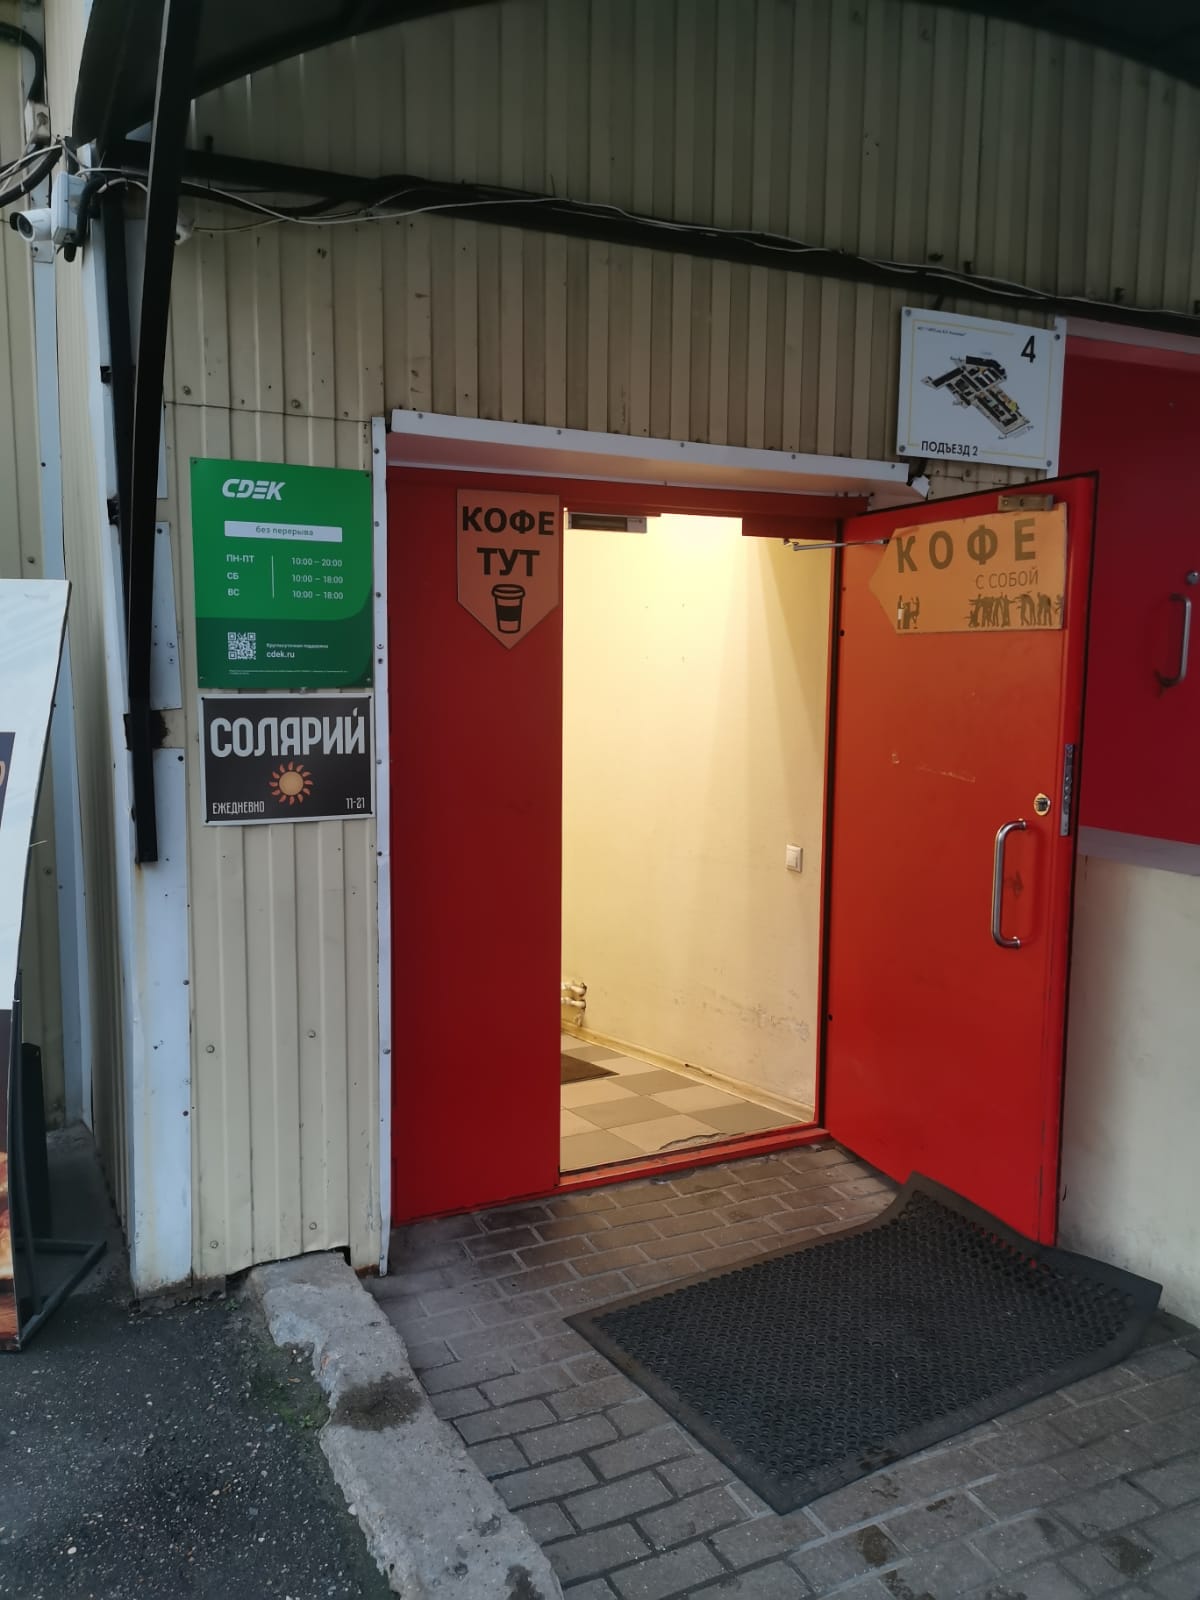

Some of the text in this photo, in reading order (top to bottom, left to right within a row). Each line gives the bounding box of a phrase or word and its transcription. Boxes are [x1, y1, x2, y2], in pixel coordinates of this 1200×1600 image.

[1020, 335, 1036, 364] 4
[921, 440, 978, 456] ПОДЪЕЗД 2
[222, 478, 286, 500] CDEK
[462, 506, 555, 536] КОФЕ
[255, 525, 314, 537] без перерыва
[896, 518, 1036, 574] КОФЕ
[226, 554, 255, 564] ПН-ПТ
[291, 557, 313, 566] 10:00
[321, 558, 343, 567] 20:00
[477, 547, 540, 577] ТУТ
[226, 572, 240, 580] СБ
[291, 574, 313, 583] 10:00
[322, 575, 344, 584] 18:00
[975, 567, 1039, 590] С СОБОЙ
[227, 588, 240, 597] ВС
[292, 590, 313, 599] 10:00
[322, 591, 344, 600] 18:00
[266, 649, 295, 658] cdek.ru
[210, 707, 365, 758] СОЛЯРИЙ
[212, 801, 265, 815] ЕЖЕДНЕВНО
[346, 797, 365, 809] 11-21
